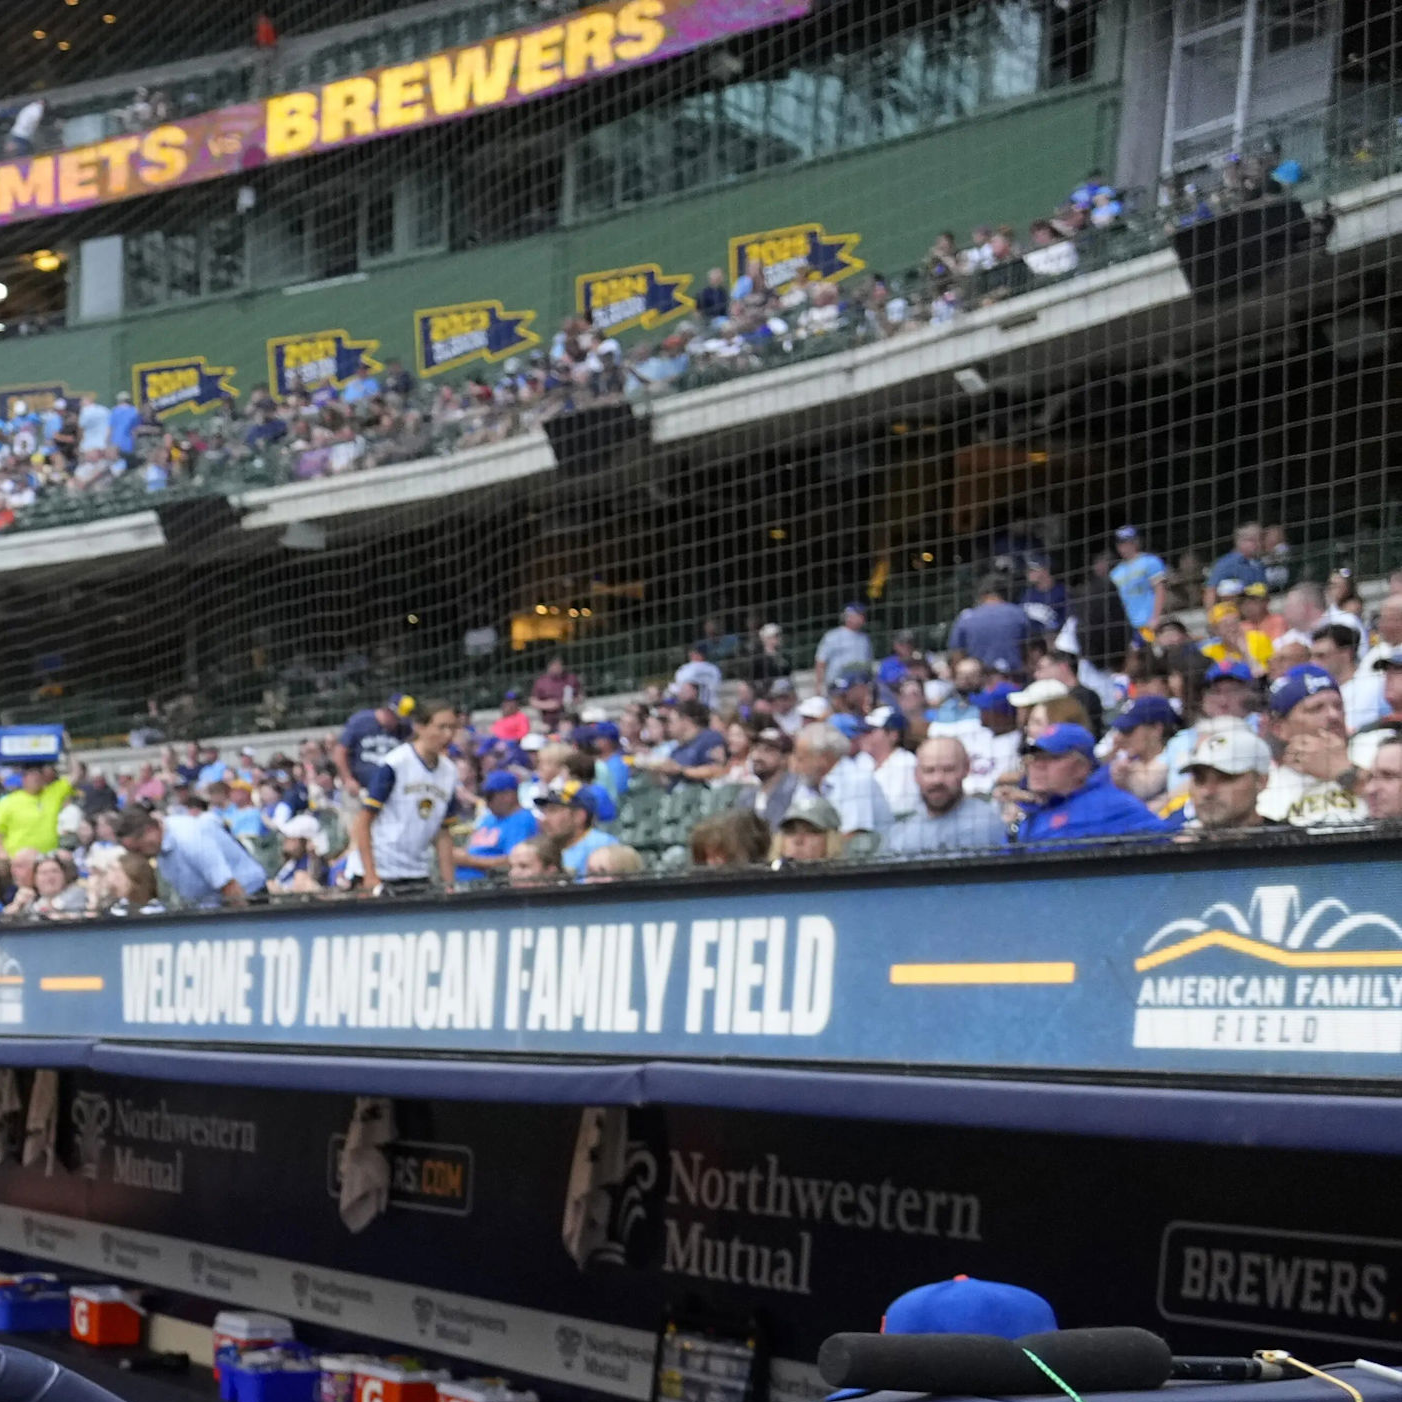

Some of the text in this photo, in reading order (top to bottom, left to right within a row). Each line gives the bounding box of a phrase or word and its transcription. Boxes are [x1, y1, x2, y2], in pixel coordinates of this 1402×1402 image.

[266, 0, 665, 159] BREWERS
[122, 914, 837, 1036] WELCOME TO AMERICAN FAMILY FIELD
[1137, 974, 1402, 1007] AMERICAN FAMILY
[1213, 1014, 1320, 1045] FIELD
[113, 1097, 257, 1153] Northwestern
[113, 1145, 183, 1194] Mutual
[666, 1149, 983, 1242] Northwestern
[662, 1217, 813, 1296] Mutual
[74, 1300, 89, 1336] G
